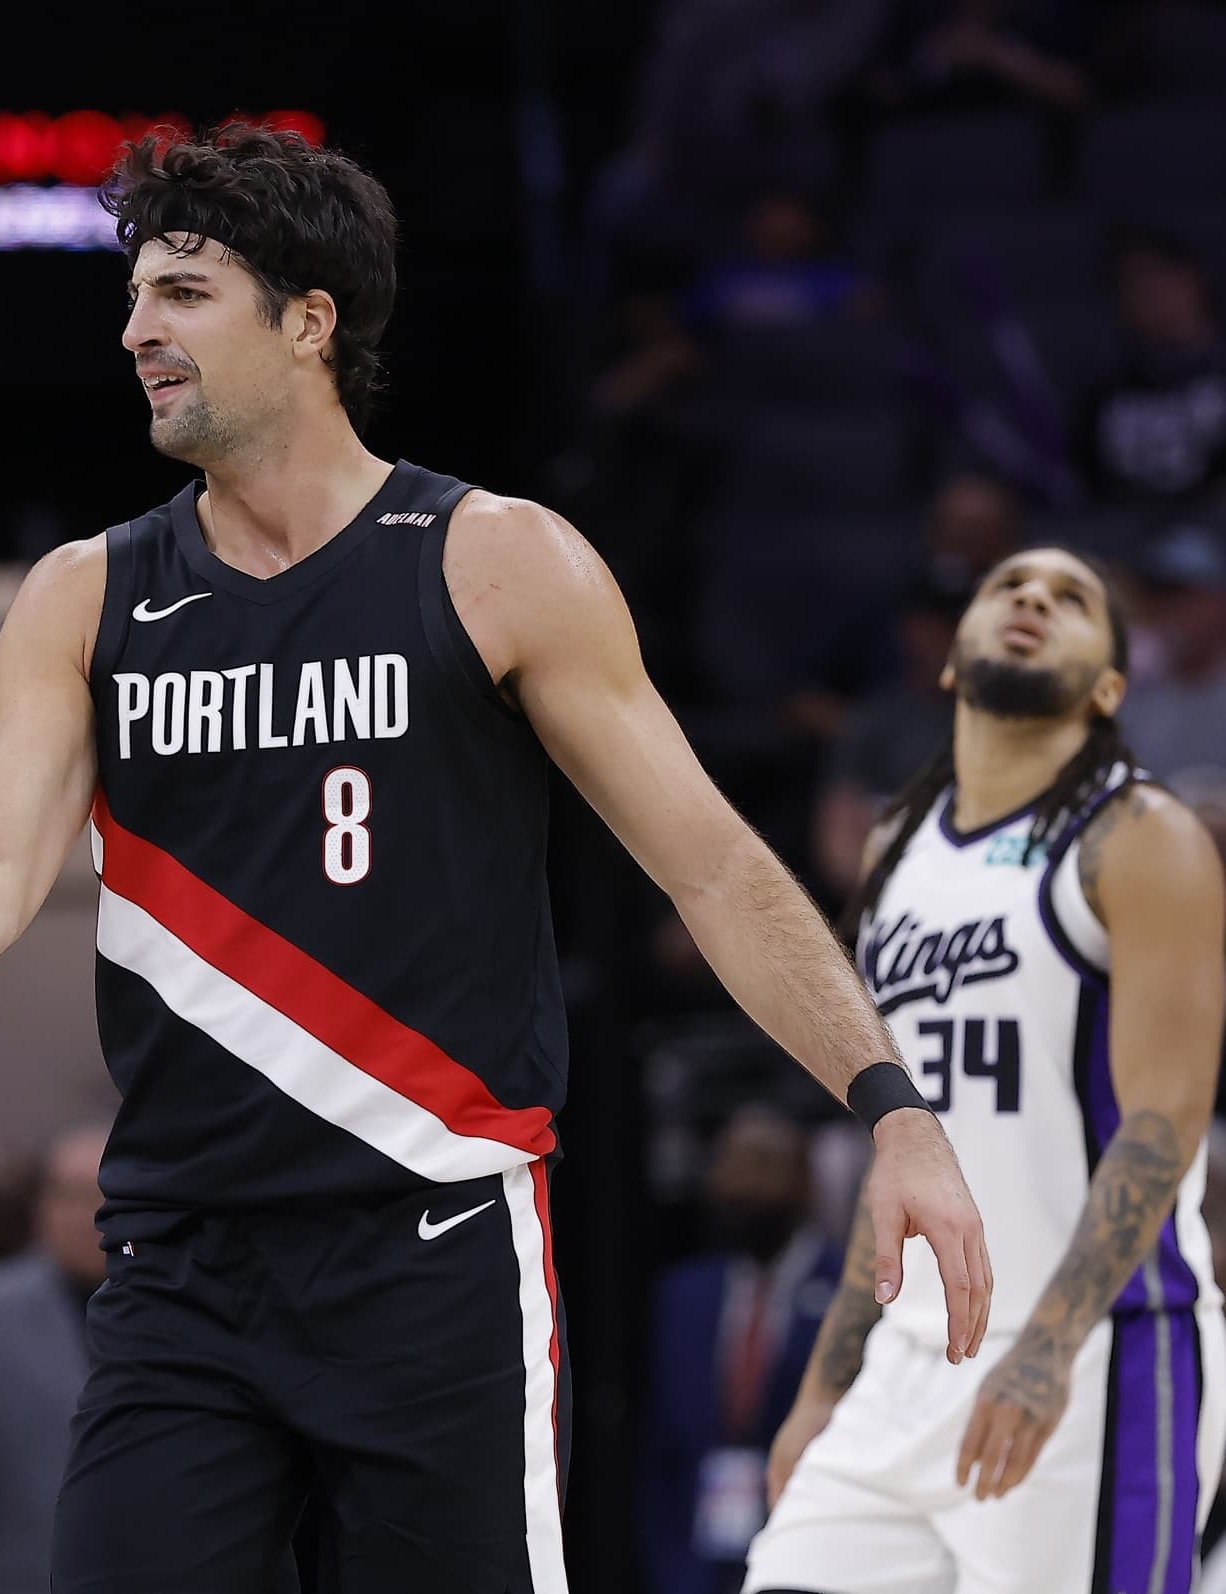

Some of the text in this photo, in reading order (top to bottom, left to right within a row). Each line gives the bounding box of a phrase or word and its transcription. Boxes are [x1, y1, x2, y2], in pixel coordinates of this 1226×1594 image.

[112, 653, 409, 760] PORTLAND
[322, 765, 372, 886] 8
[864, 912, 1019, 1016] Kings
[917, 1018, 1020, 1113] 34
